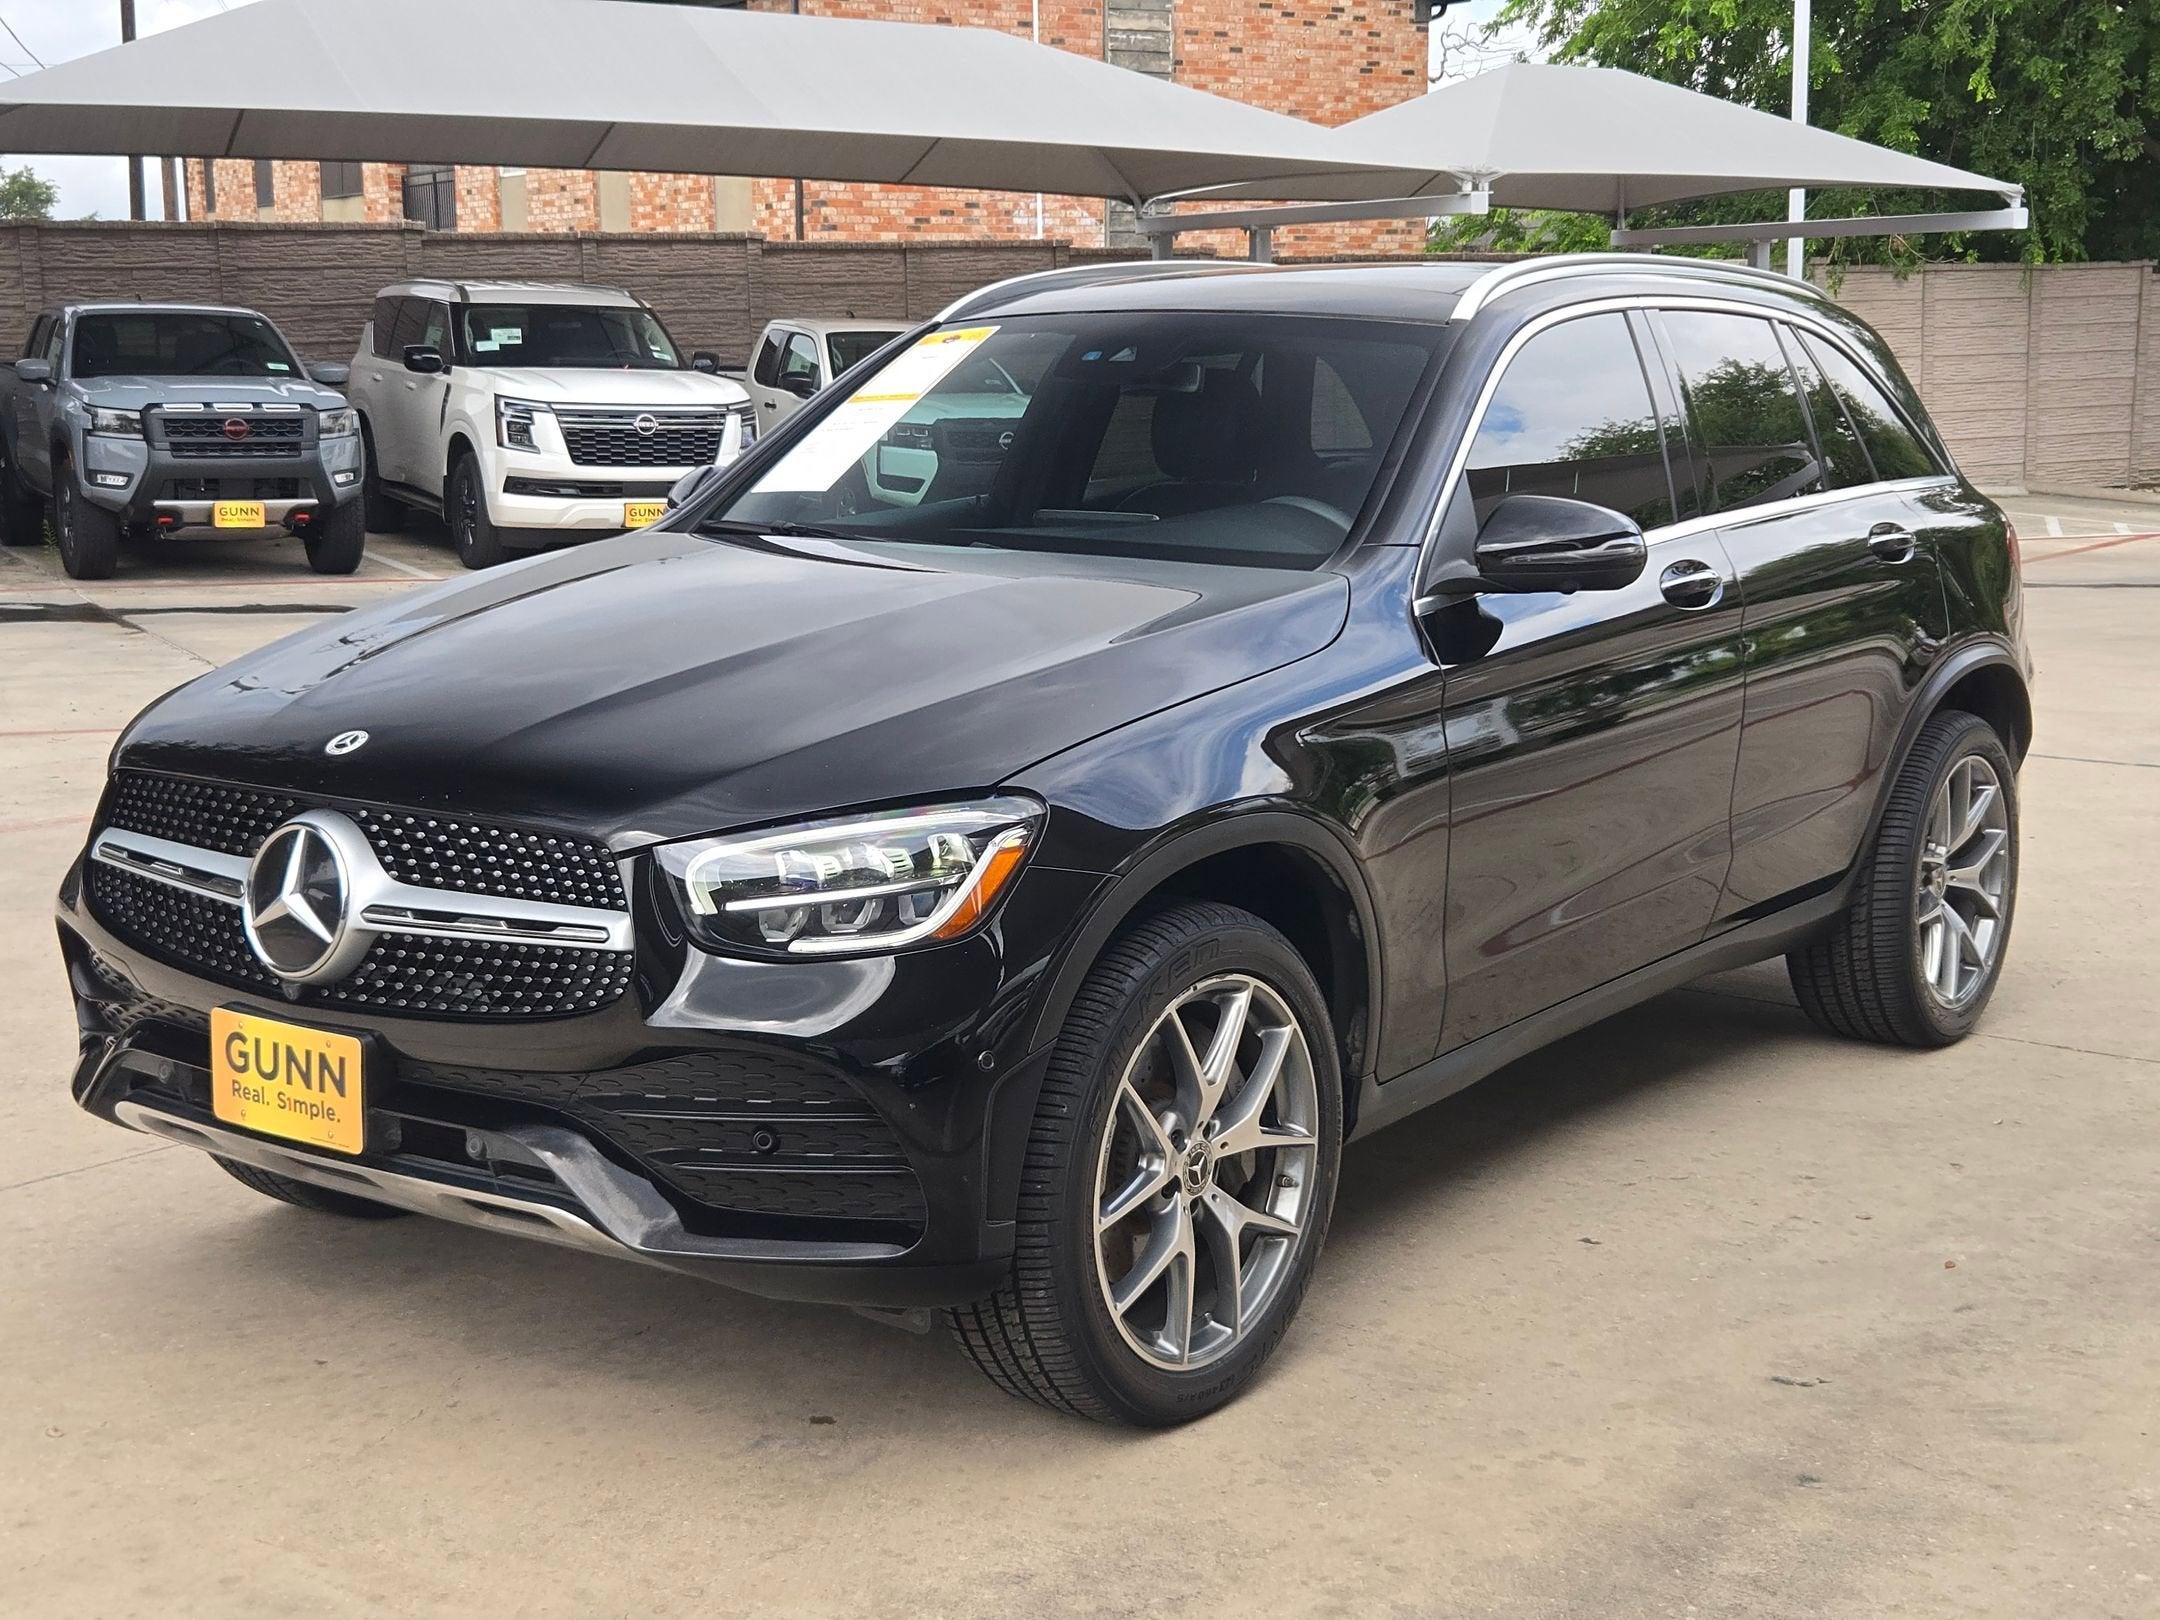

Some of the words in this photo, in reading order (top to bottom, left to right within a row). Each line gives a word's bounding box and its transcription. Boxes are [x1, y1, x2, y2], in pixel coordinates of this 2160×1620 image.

[219, 506, 260, 517] GUNN
[629, 507, 666, 517] GUNN
[225, 1031, 347, 1099] GUNN
[231, 1078, 270, 1106] Real.
